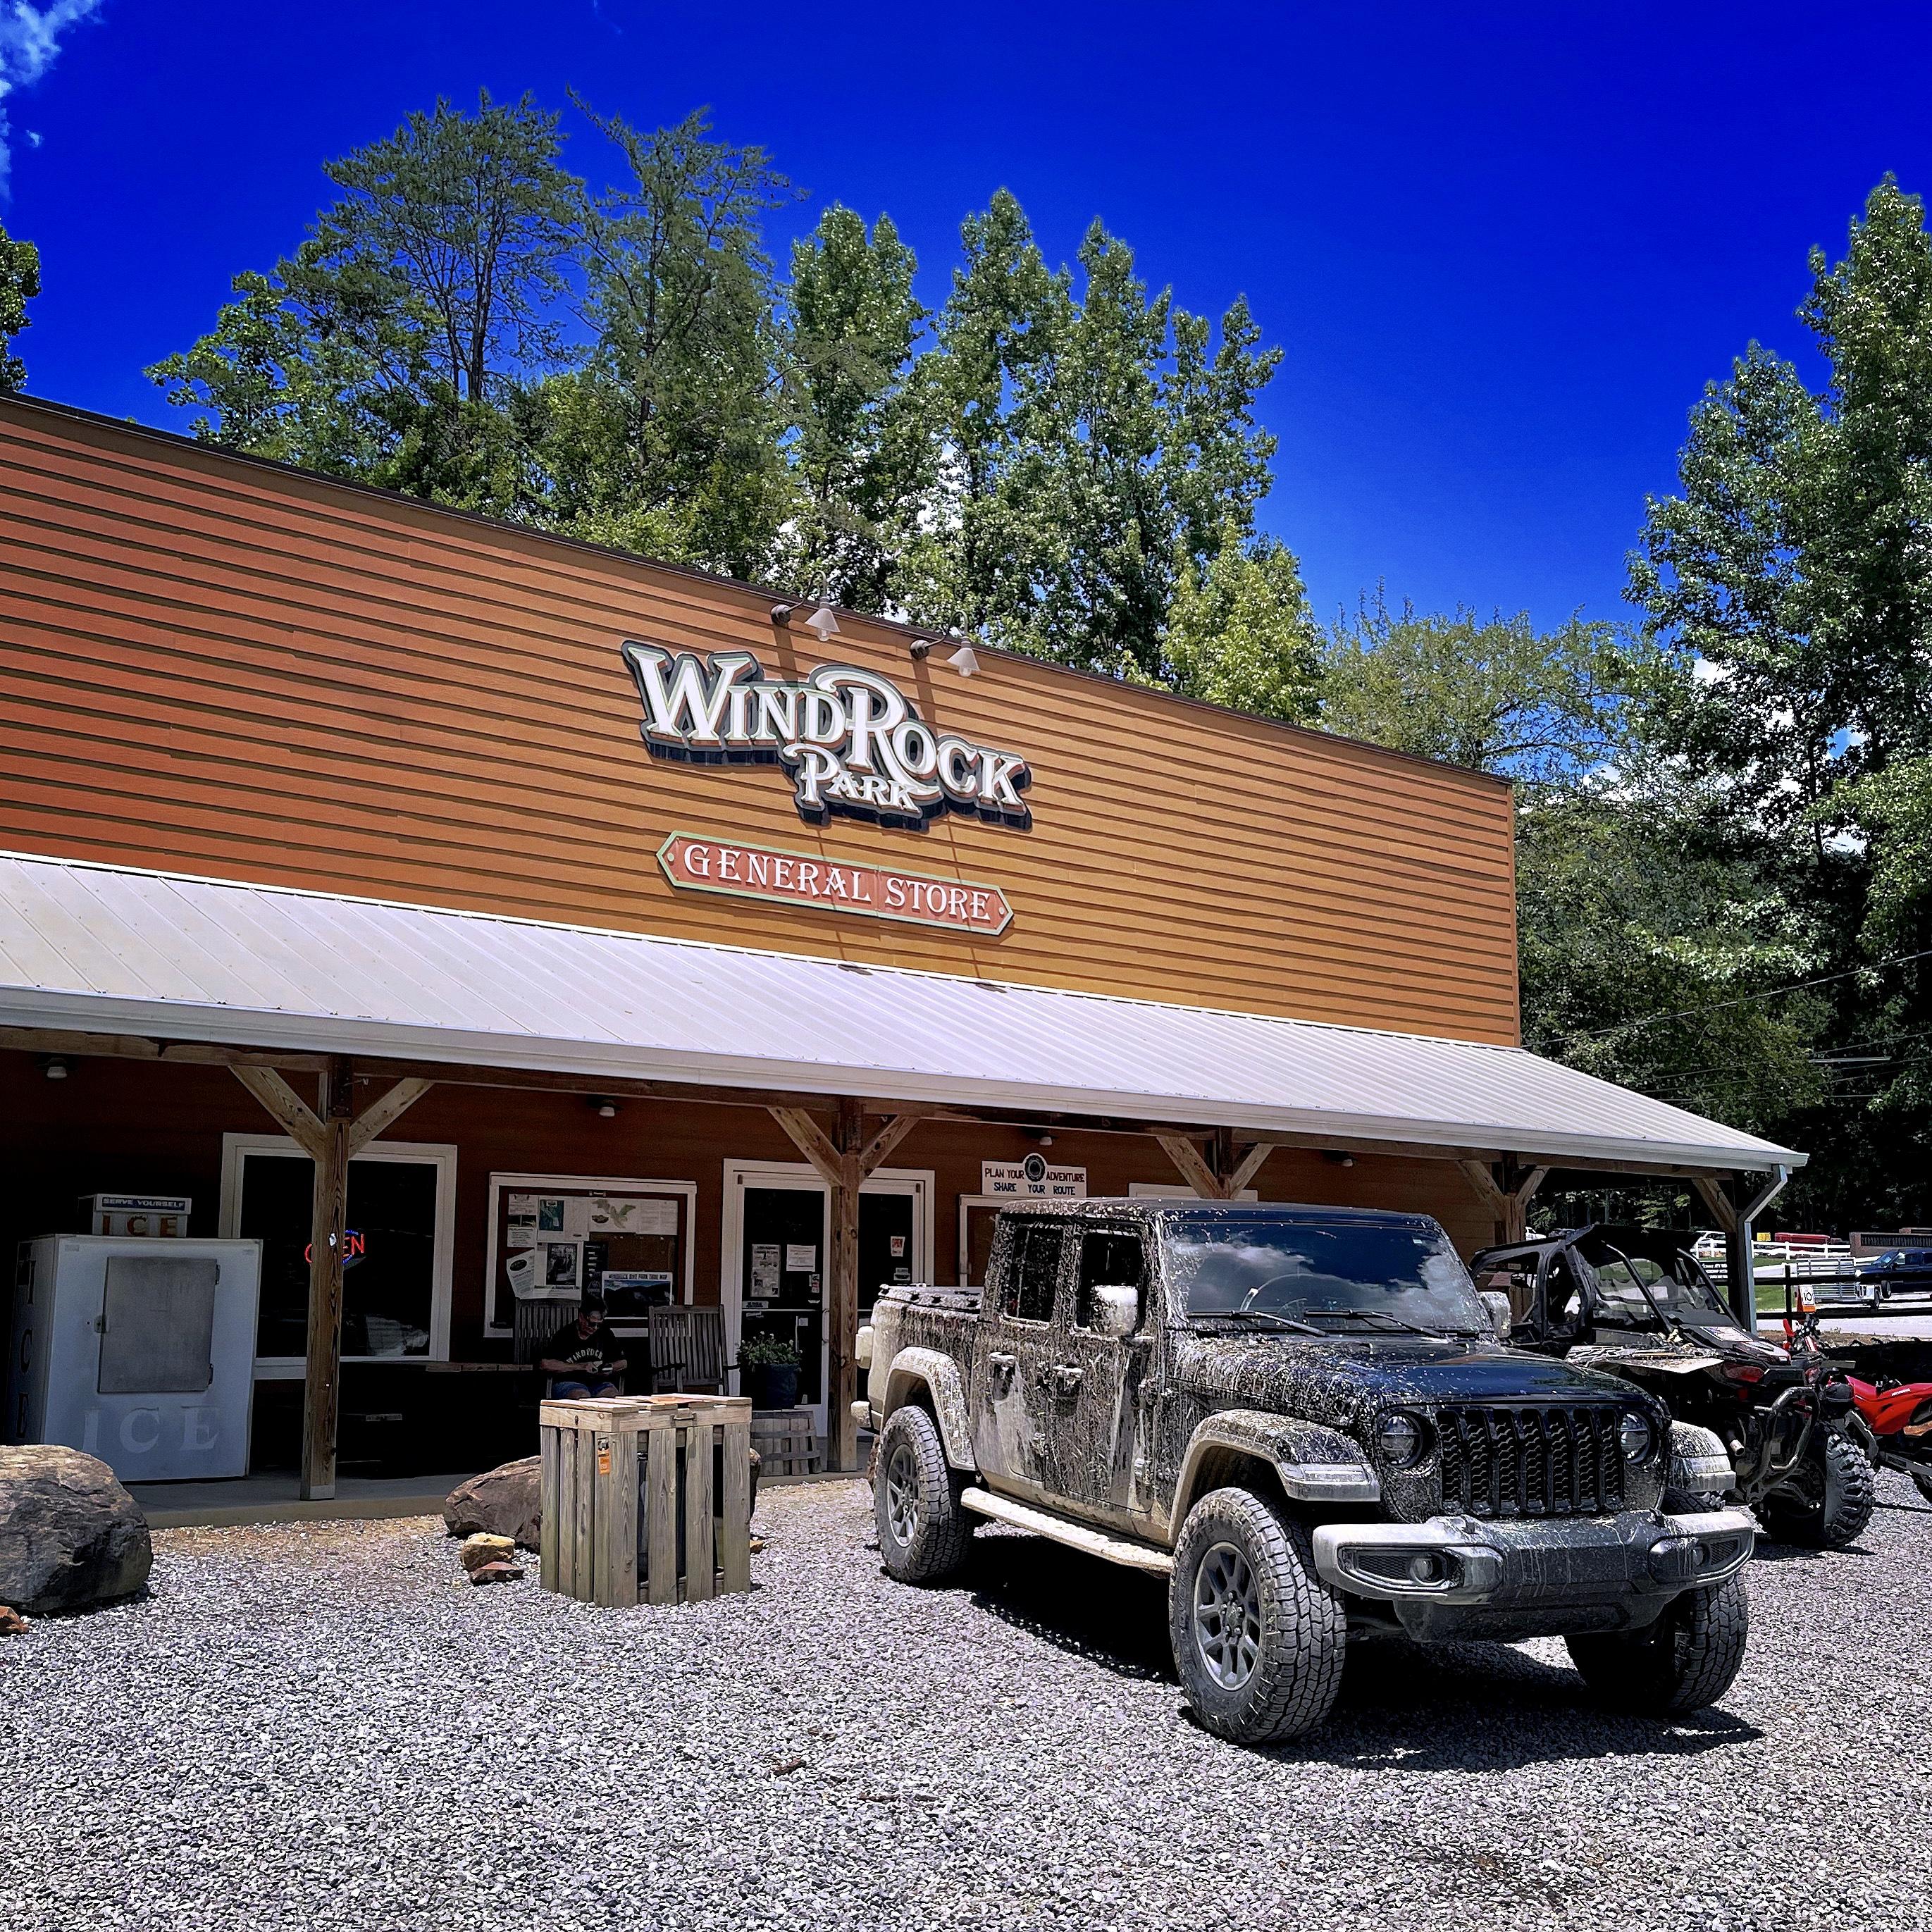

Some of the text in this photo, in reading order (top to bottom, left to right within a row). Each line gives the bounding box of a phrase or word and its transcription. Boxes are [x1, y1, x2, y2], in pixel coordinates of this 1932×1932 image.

[782, 744, 919, 812] PARK
[684, 843, 992, 924] GENERAL STORE
[984, 1168, 1085, 1183] PLAN YOUR ADVENTURE
[993, 1182, 1076, 1196] SHARE YOUR ROUTE
[137, 1199, 185, 1208] YOURSELF
[102, 1211, 178, 1237] ICE
[1804, 1292, 1812, 1301] 10
[82, 1406, 221, 1454] ICE
